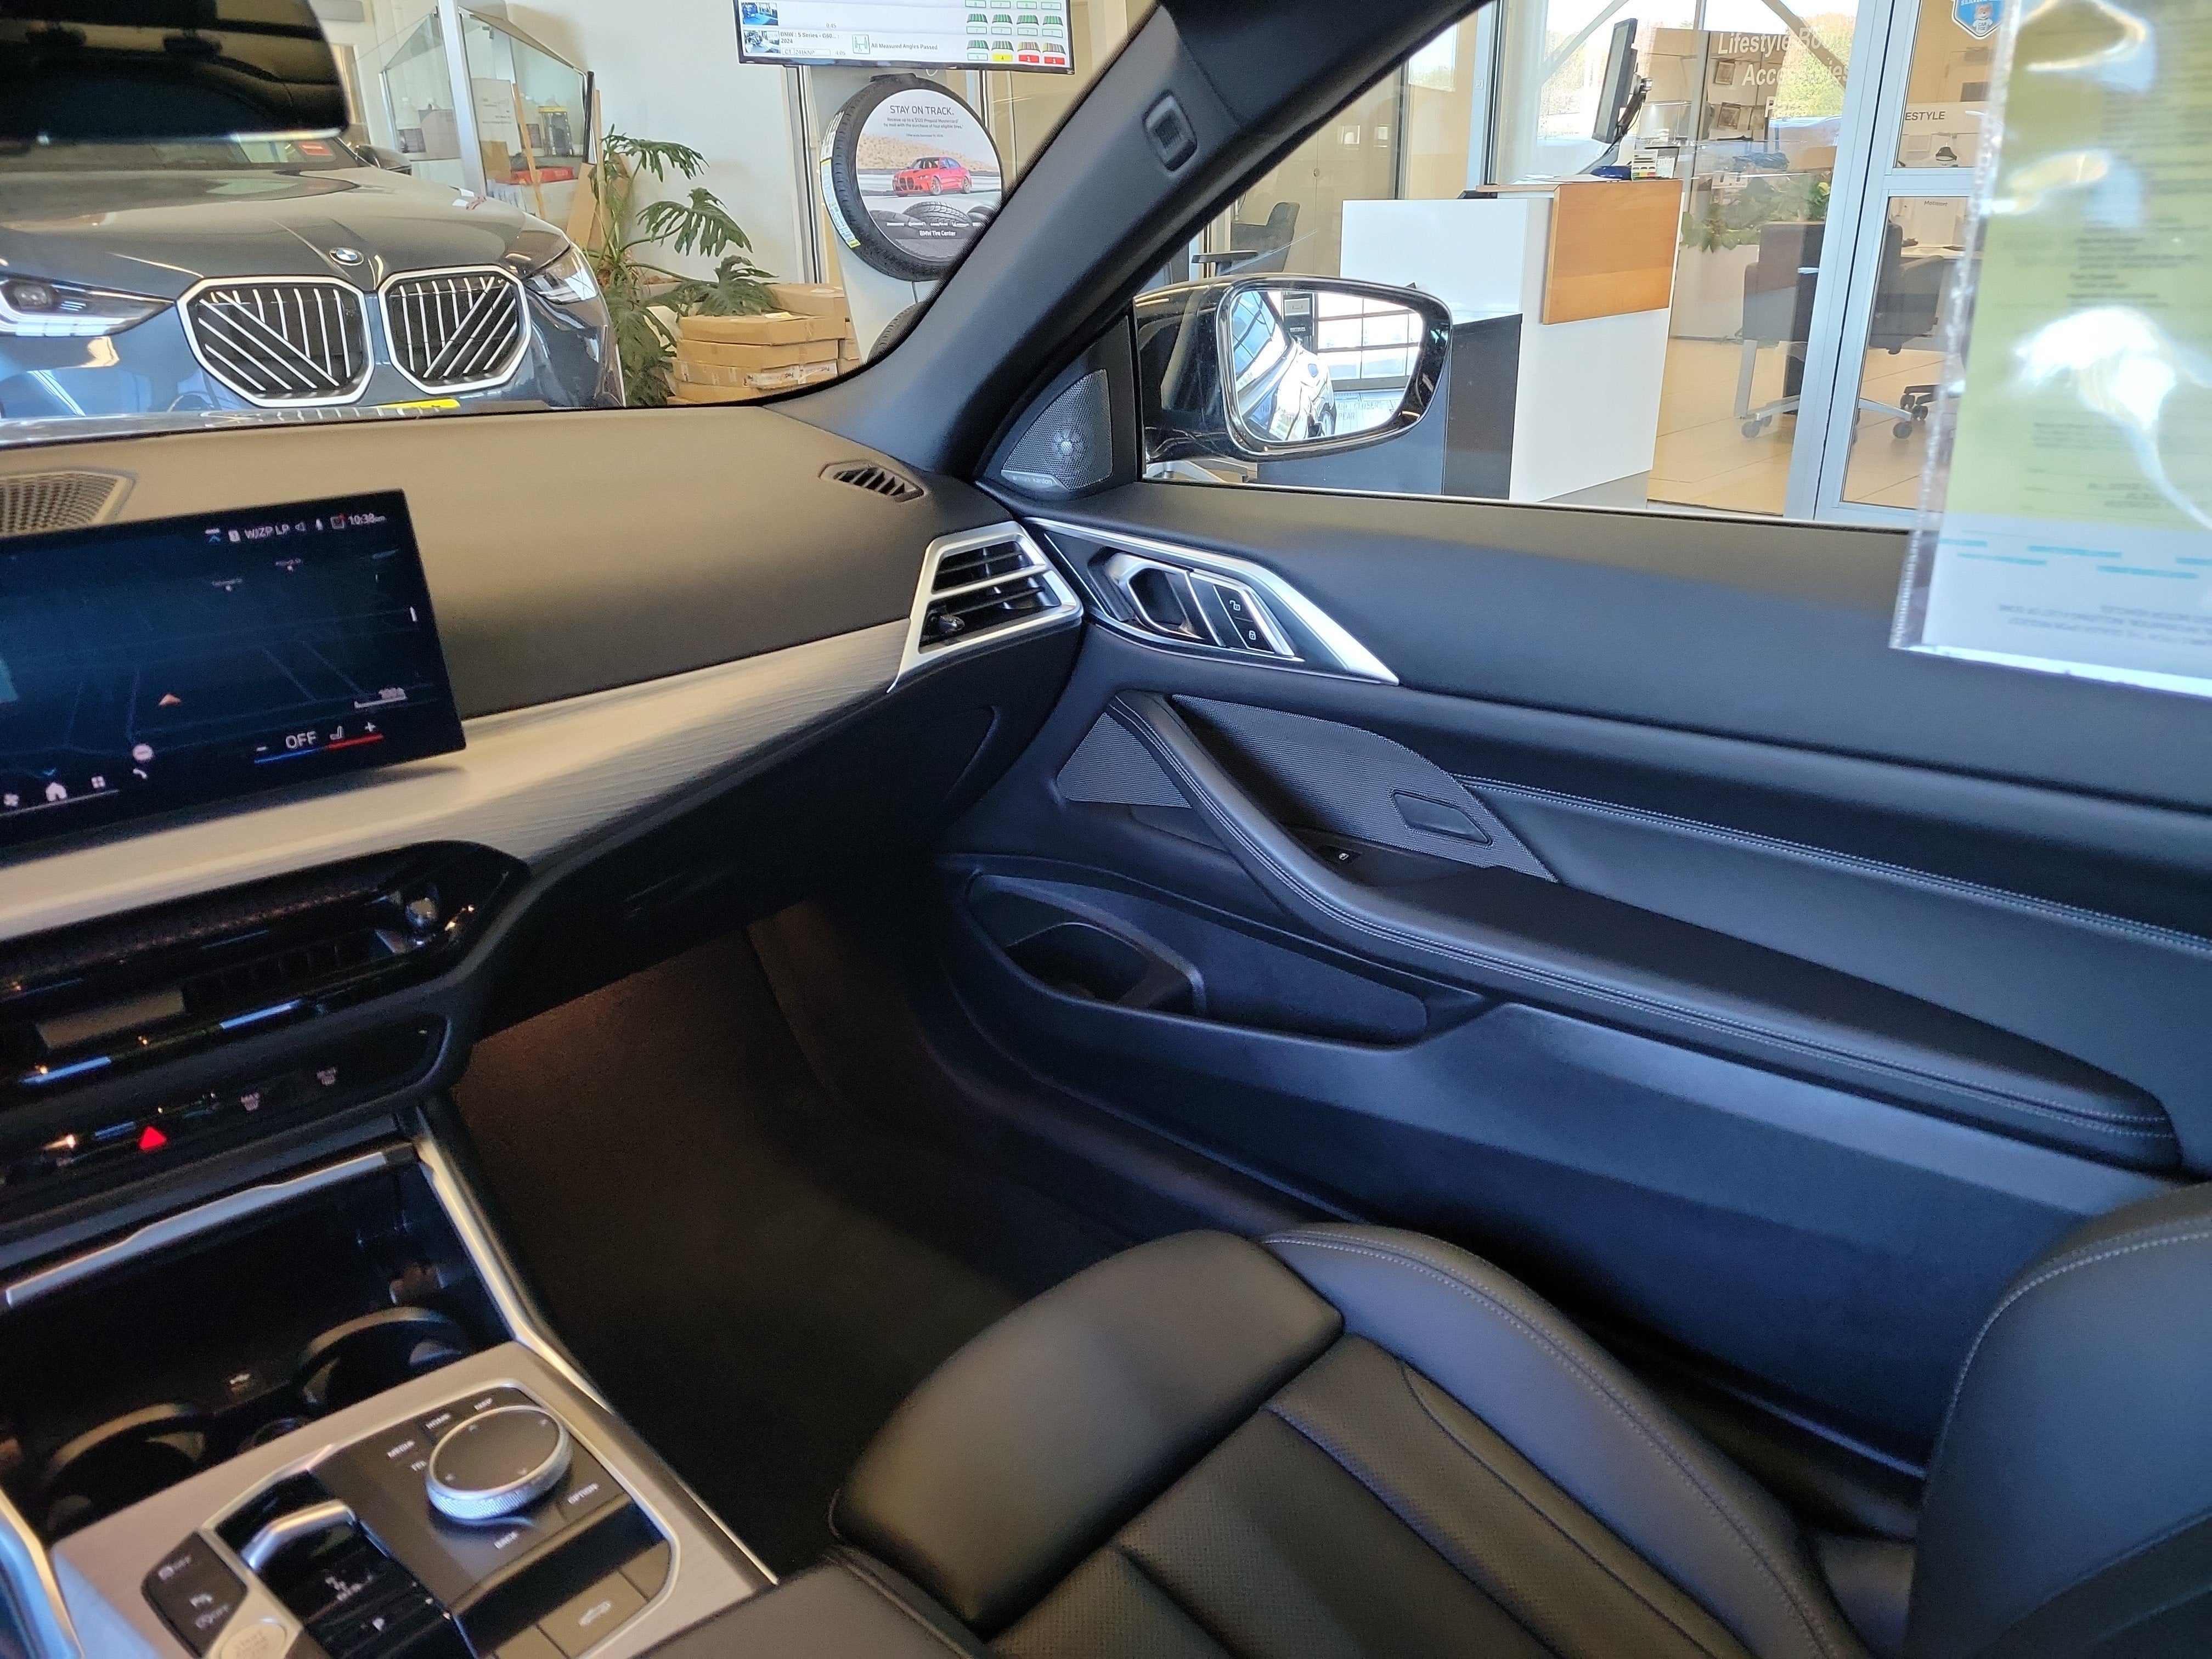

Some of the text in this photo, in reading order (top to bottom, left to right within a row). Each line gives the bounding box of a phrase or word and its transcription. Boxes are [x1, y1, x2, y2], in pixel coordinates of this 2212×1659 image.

[1718, 31, 1790, 58] Lifestyle
[890, 105, 954, 116] STAY ON TRACK.
[275, 523, 291, 535] LP
[285, 730, 317, 749] OFF
